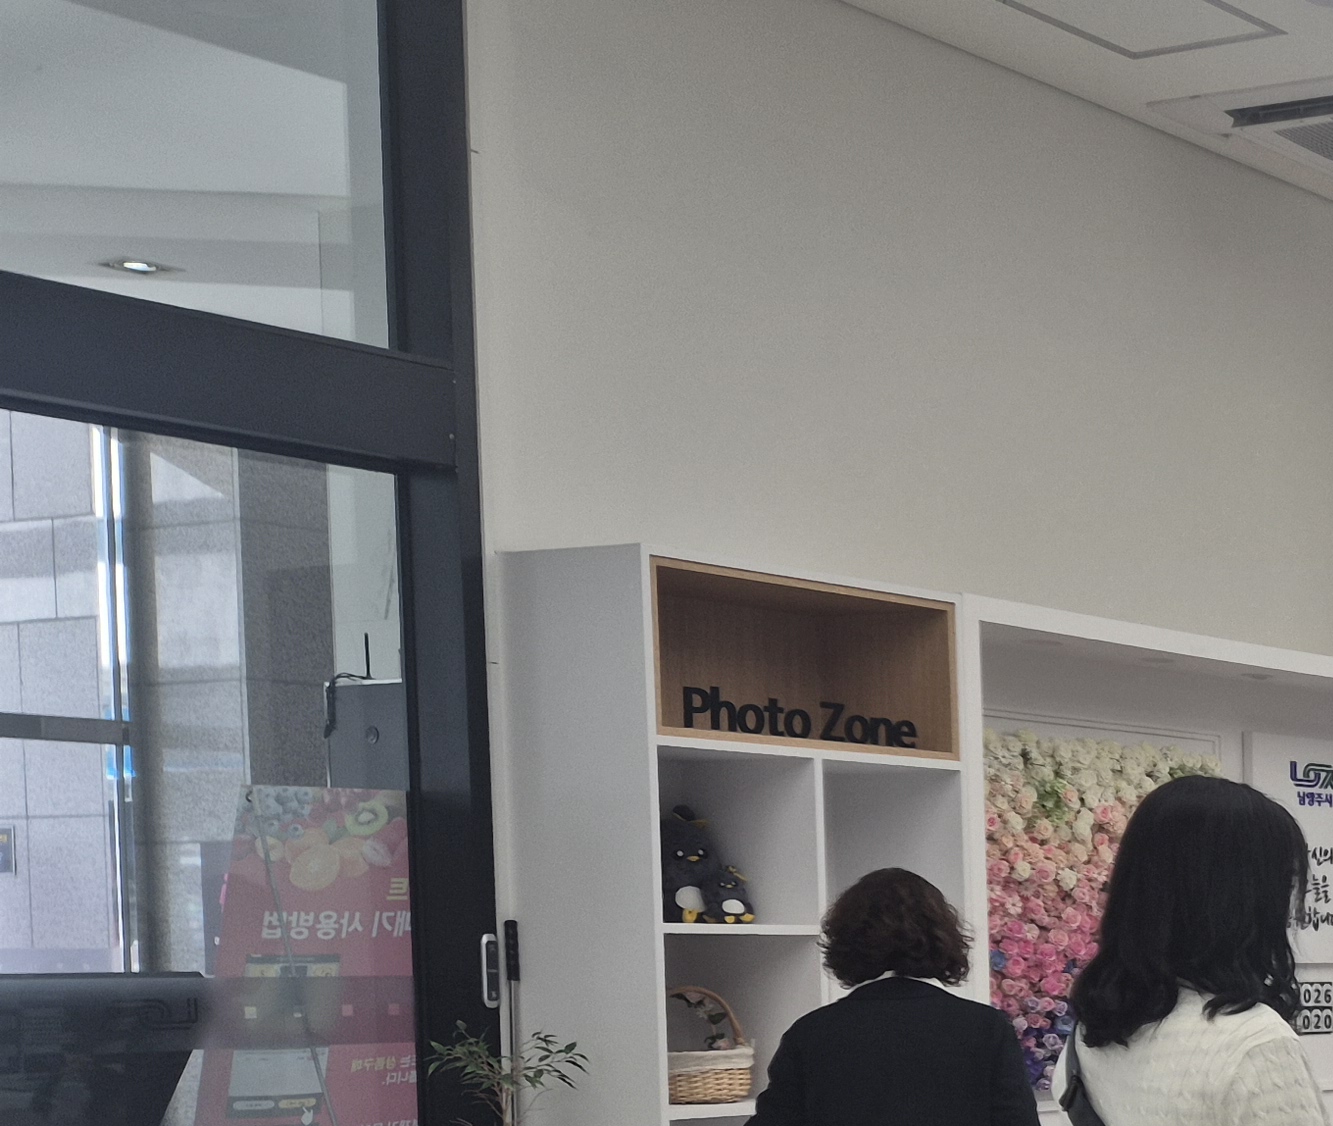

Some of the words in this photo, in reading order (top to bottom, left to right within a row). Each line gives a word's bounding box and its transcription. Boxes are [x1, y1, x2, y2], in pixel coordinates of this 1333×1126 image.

[683, 686, 811, 741] Photo
[821, 702, 918, 750] Zone
[1307, 846, 1333, 867] 신의
[1304, 873, 1332, 904] 늘을
[1303, 988, 1332, 1004] 026
[1302, 1014, 1332, 1030] 020
